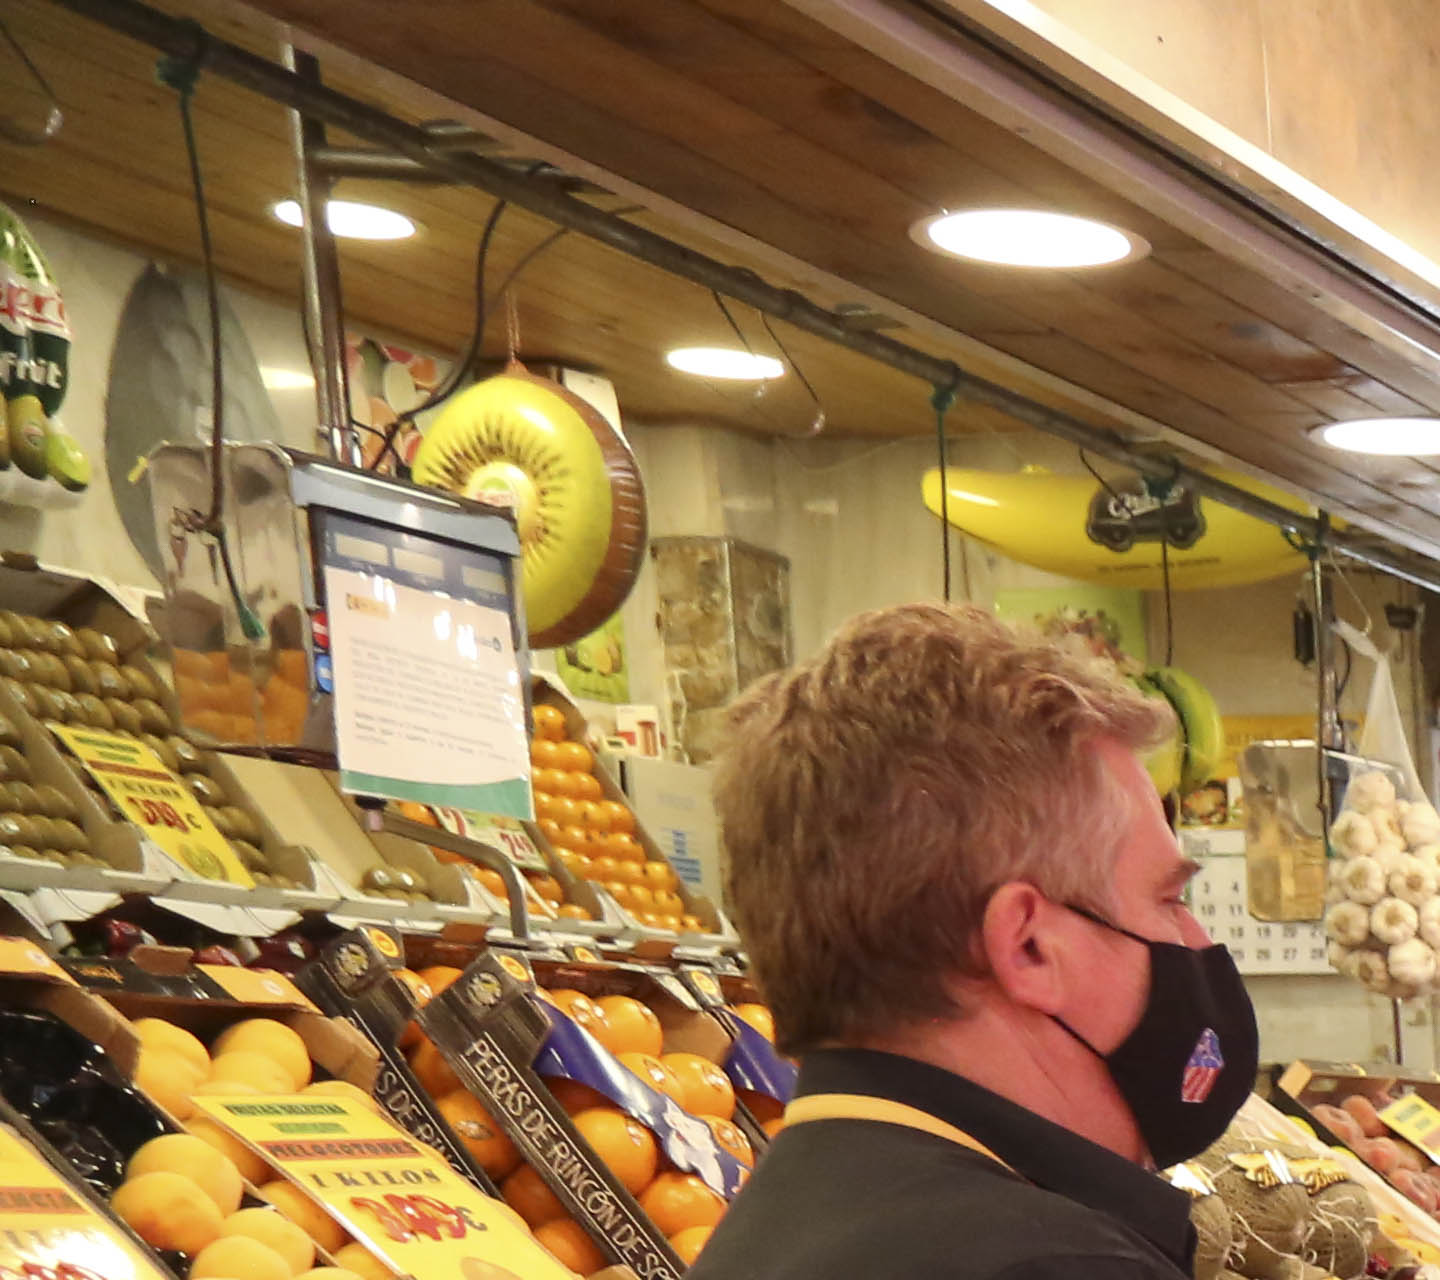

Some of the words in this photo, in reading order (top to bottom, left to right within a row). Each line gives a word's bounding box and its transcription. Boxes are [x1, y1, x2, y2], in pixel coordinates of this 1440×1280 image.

[268, 1141, 421, 1159] MELOCOTONES
[464, 1039, 531, 1119] PERAS
[519, 1110, 556, 1149] DE
[548, 1141, 624, 1232] RINCÓN
[612, 1222, 648, 1258] DE
[335, 1168, 442, 1188] KILOS
